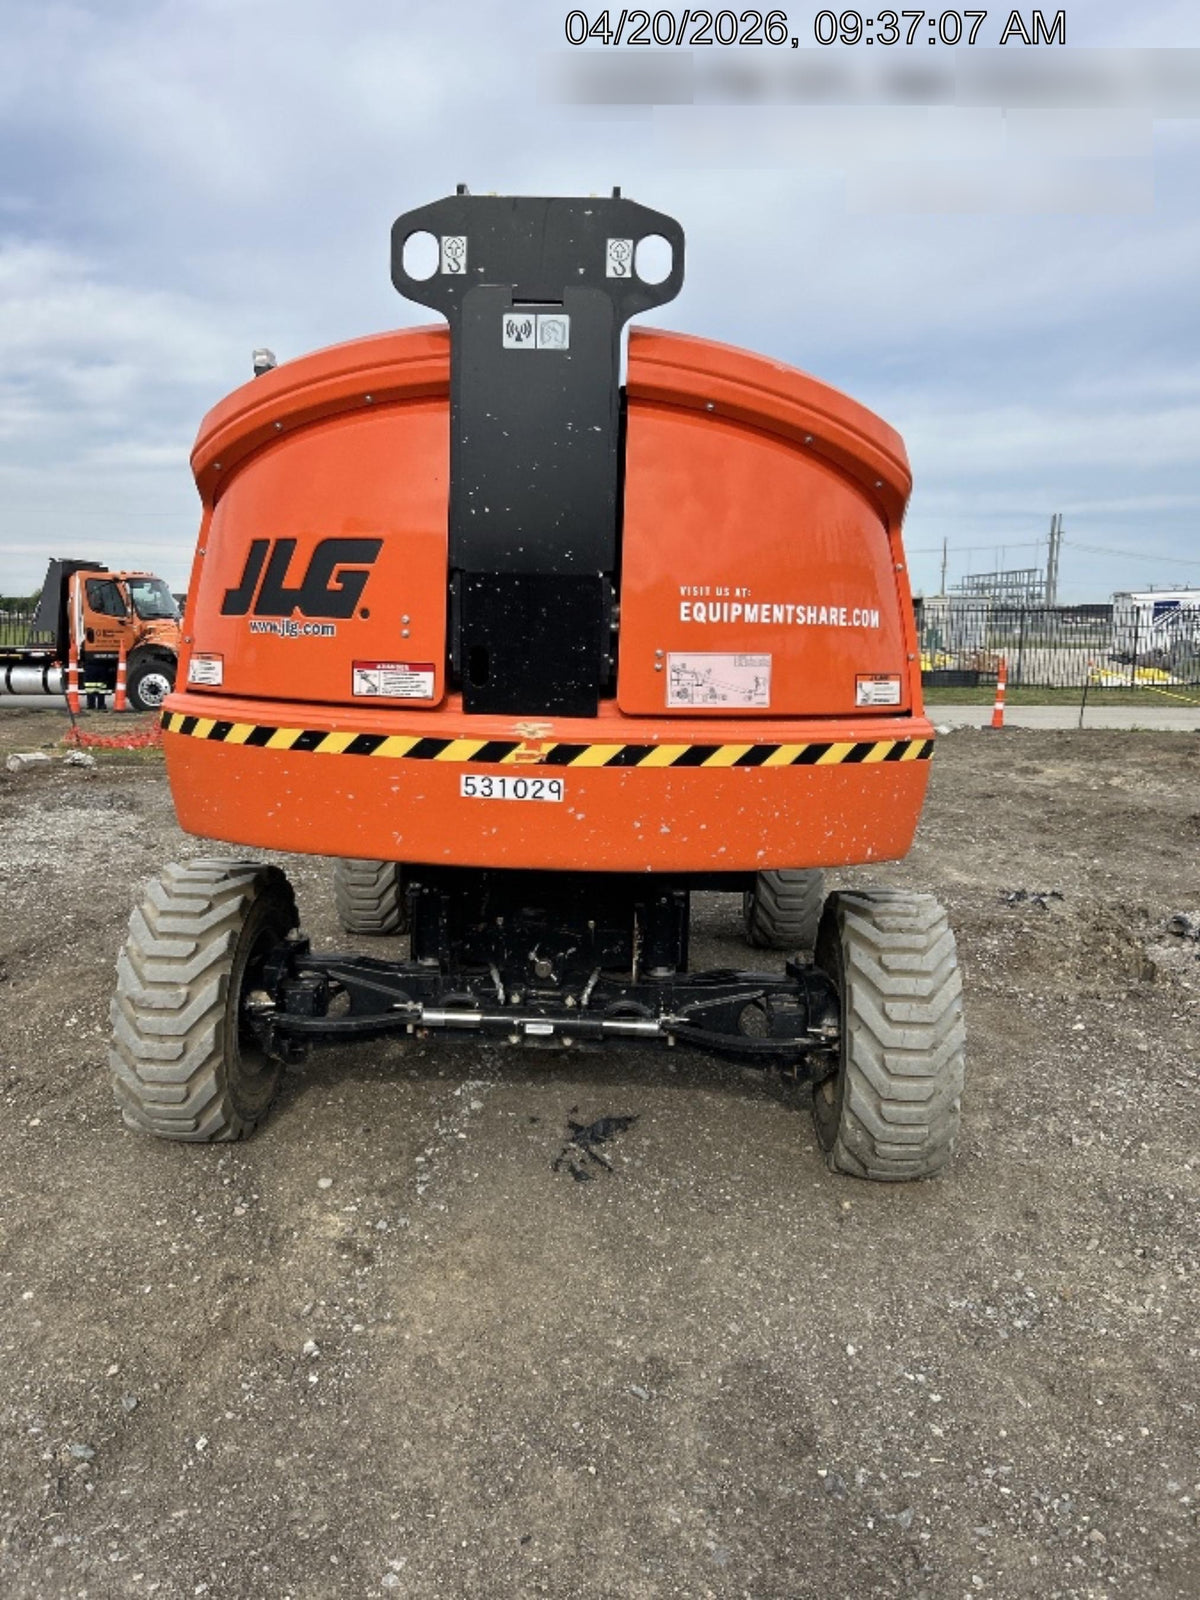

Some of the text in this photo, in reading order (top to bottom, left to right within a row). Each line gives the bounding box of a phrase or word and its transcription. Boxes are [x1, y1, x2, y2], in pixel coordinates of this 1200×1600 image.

[680, 586, 752, 598] VISIT US AT:
[680, 602, 880, 628] EQUIPMENTSHARE.COM
[250, 619, 336, 637] www.jlg.com
[464, 776, 562, 800] 531029
